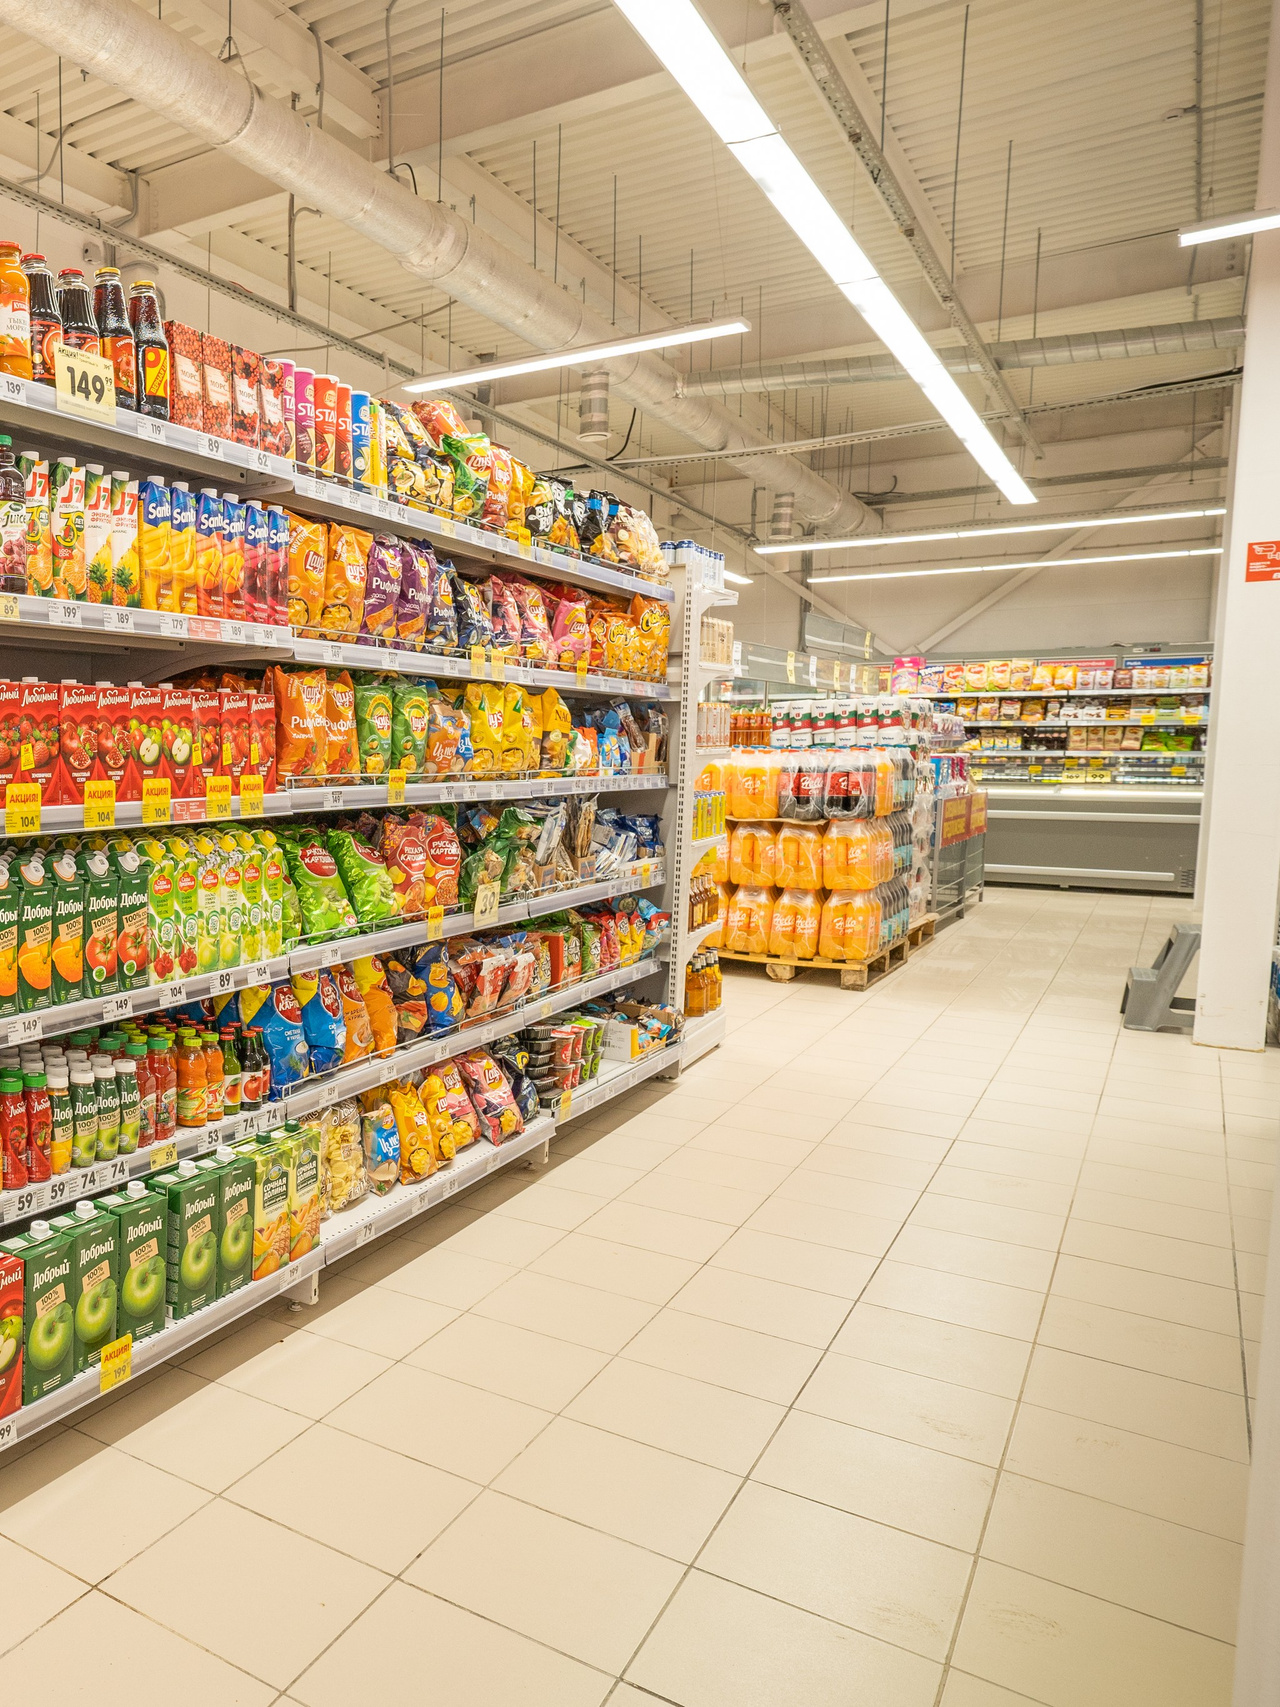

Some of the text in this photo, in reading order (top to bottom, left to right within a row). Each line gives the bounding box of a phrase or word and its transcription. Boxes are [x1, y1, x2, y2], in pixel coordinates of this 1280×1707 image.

[6, 381, 20, 395] 139
[67, 366, 113, 404] 149 99
[150, 370, 164, 394] ВЕРНАЯ
[151, 423, 161, 434] 119
[208, 438, 219, 452] 89
[258, 453, 268, 467] 62
[26, 472, 47, 498] J7
[61, 477, 85, 503] J7
[88, 485, 110, 511] J7
[113, 491, 138, 516] J7
[4, 510, 26, 526] Juice
[4, 604, 14, 615] 89
[63, 606, 76, 617] 199
[21, 686, 58, 707] Любимый
[62, 688, 96, 709] Любимый
[97, 689, 129, 709] Любимый
[130, 690, 161, 709] Любимый
[162, 691, 191, 710] Любимый
[192, 692, 219, 710] Любимый
[222, 692, 247, 712] Любимый
[251, 694, 275, 713] Любимый
[145, 786, 169, 796] АКЦИЯ!
[208, 783, 230, 793] АКЦИЯ!
[242, 781, 262, 792] АКЦИЯ!
[9, 793, 39, 804] АКЦИЯ!
[87, 789, 114, 799] АКЦИЯ!
[154, 808, 166, 818] 104
[217, 804, 227, 813] 104
[21, 817, 35, 827] 104
[97, 812, 110, 822] 104
[257, 967, 267, 977] 104
[220, 974, 230, 986] 89
[171, 988, 182, 998] 104
[116, 1001, 128, 1011] 149
[23, 1021, 37, 1032] 149
[244, 1120, 255, 1131] 74
[208, 1132, 219, 1144] 53
[112, 1162, 126, 1175] 74
[81, 1172, 96, 1186] 74
[263, 1177, 286, 1192] СОЧНАЯ
[51, 1184, 65, 1197] 59
[224, 1178, 252, 1202] Добрый
[18, 1195, 33, 1211] 59
[185, 1194, 215, 1220] Добрый
[230, 1202, 244, 1215] 100%
[127, 1216, 162, 1243] Добрый
[191, 1219, 206, 1232] 100%
[79, 1238, 114, 1267] Добрый
[134, 1244, 152, 1258] 100%
[32, 1261, 71, 1291] Добрый
[86, 1267, 104, 1281] 100%
[40, 1290, 58, 1305] 100%
[104, 1343, 130, 1363] АКЦИЯ!
[114, 1365, 126, 1378] 199
